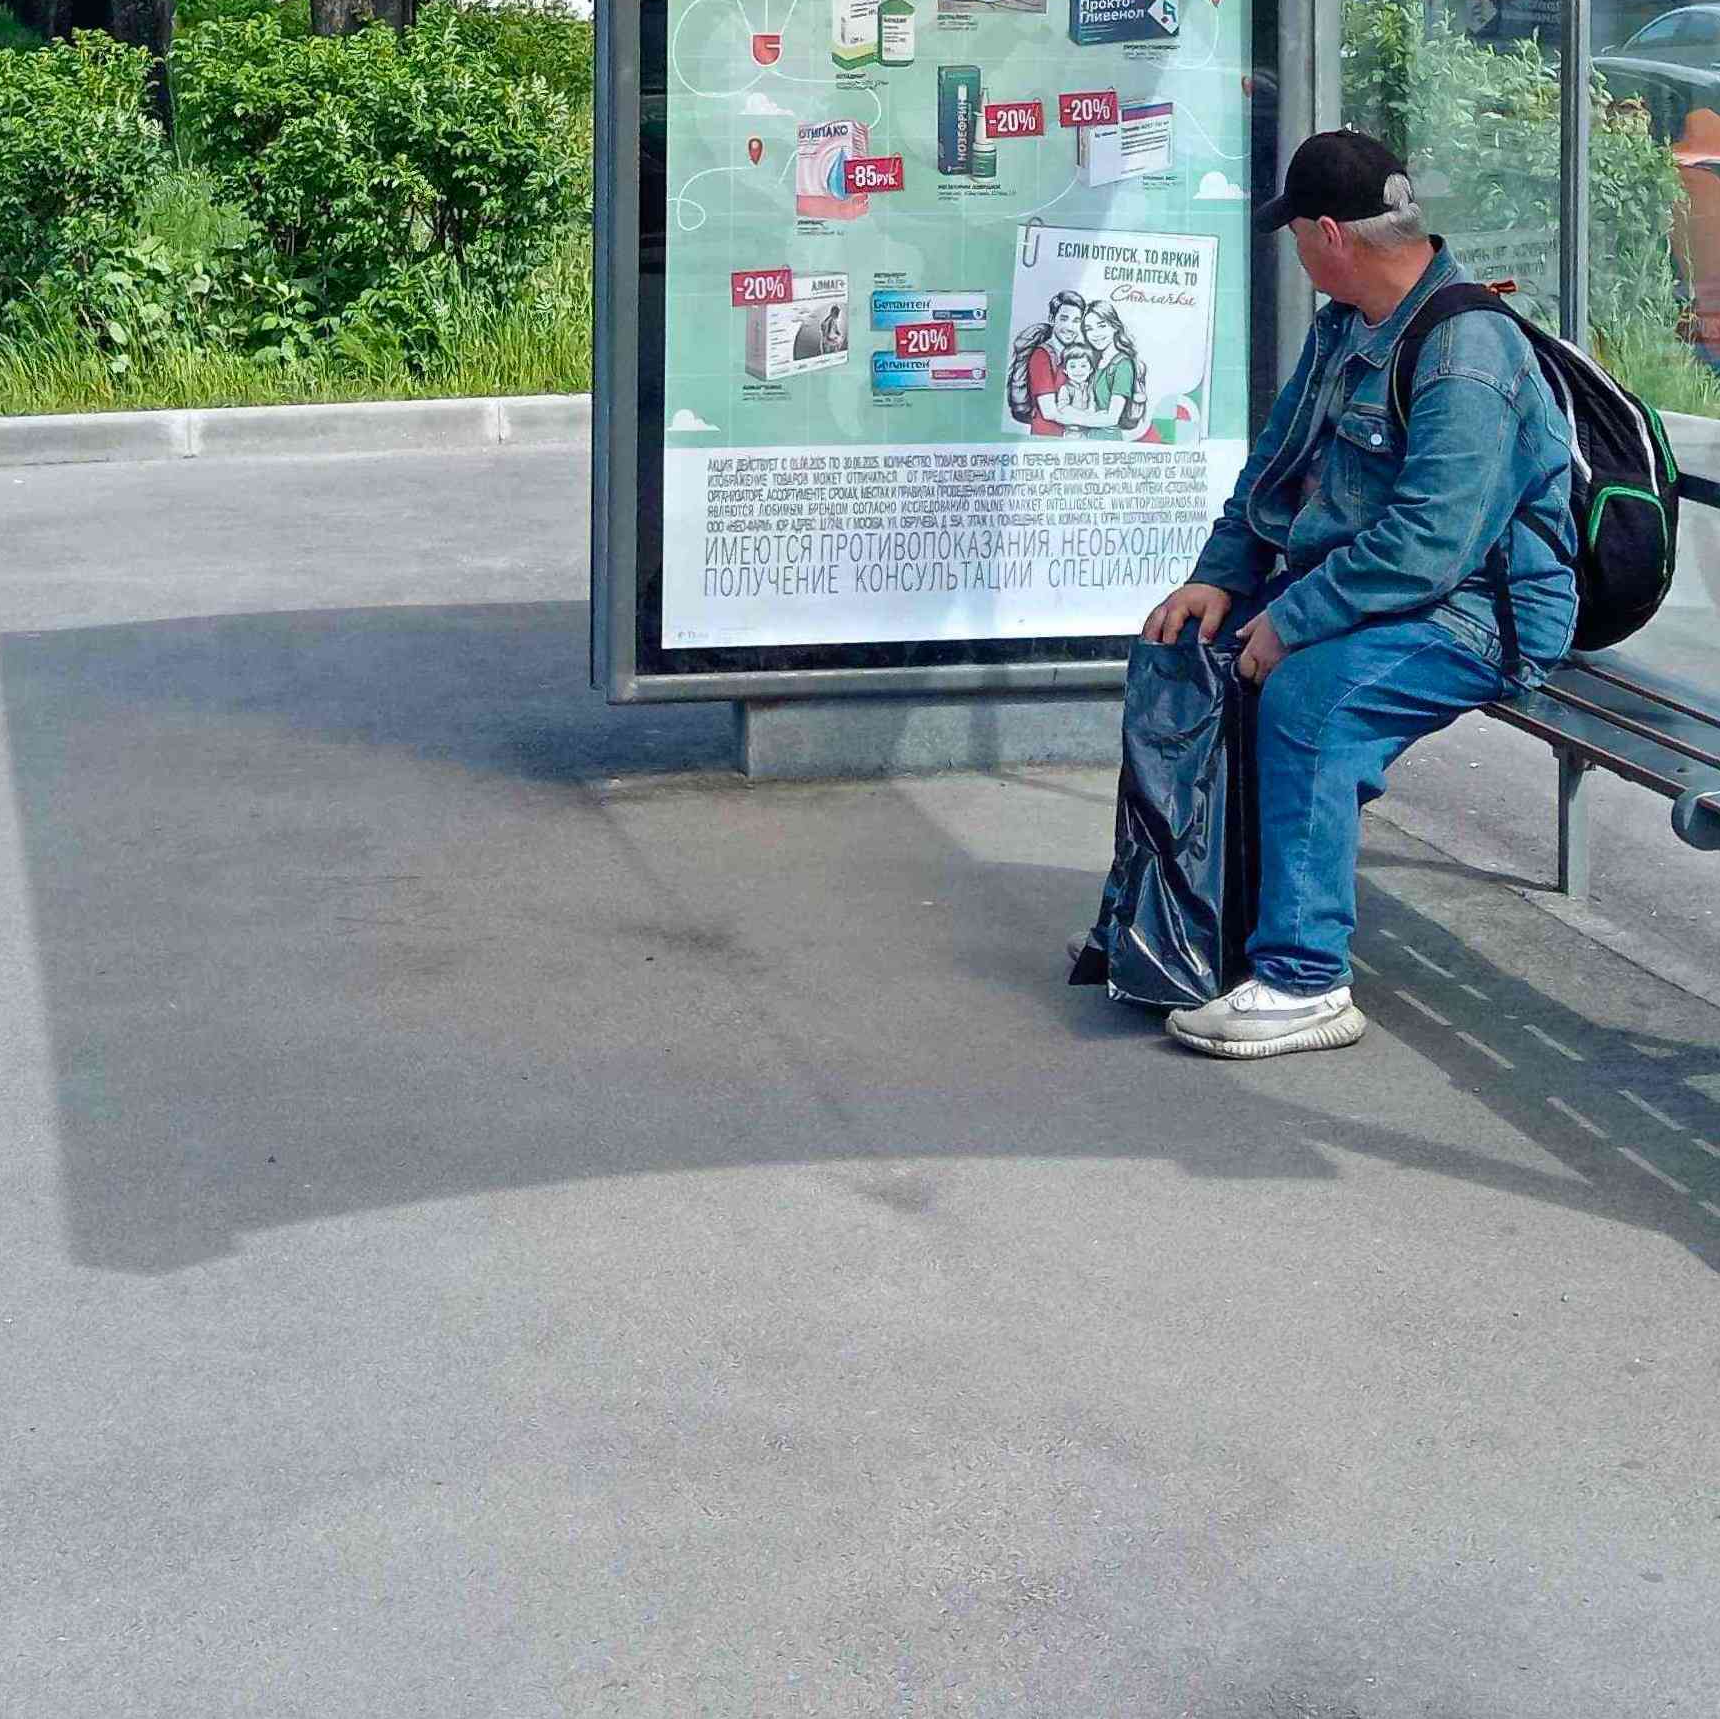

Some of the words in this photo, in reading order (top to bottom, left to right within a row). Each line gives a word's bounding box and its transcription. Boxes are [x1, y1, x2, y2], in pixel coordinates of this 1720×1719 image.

[1080, 7, 1145, 24] Гливенол
[989, 109, 1036, 131] -20%
[1064, 97, 1110, 121] -20%
[1057, 242, 1089, 259] ЕСЛИ
[1093, 245, 1141, 264] ОТПУСК,
[1145, 249, 1159, 265] ТО
[1161, 250, 1200, 268] ЯРКИЙ
[736, 276, 784, 300] -20%
[1104, 266, 1135, 281] ЕСЛИ
[1185, 271, 1198, 286] ТО
[900, 328, 947, 353] -20%
[705, 535, 812, 566] ИМЕЮТСЯ
[1061, 526, 1207, 558] НЕОБХОДИМО
[704, 564, 839, 598] ПОЛУЧЕНИЕ
[856, 559, 1032, 593] КОНСУЛЬТАЦИИ
[1048, 556, 1193, 591] СПЕЦИАЛИСТ
